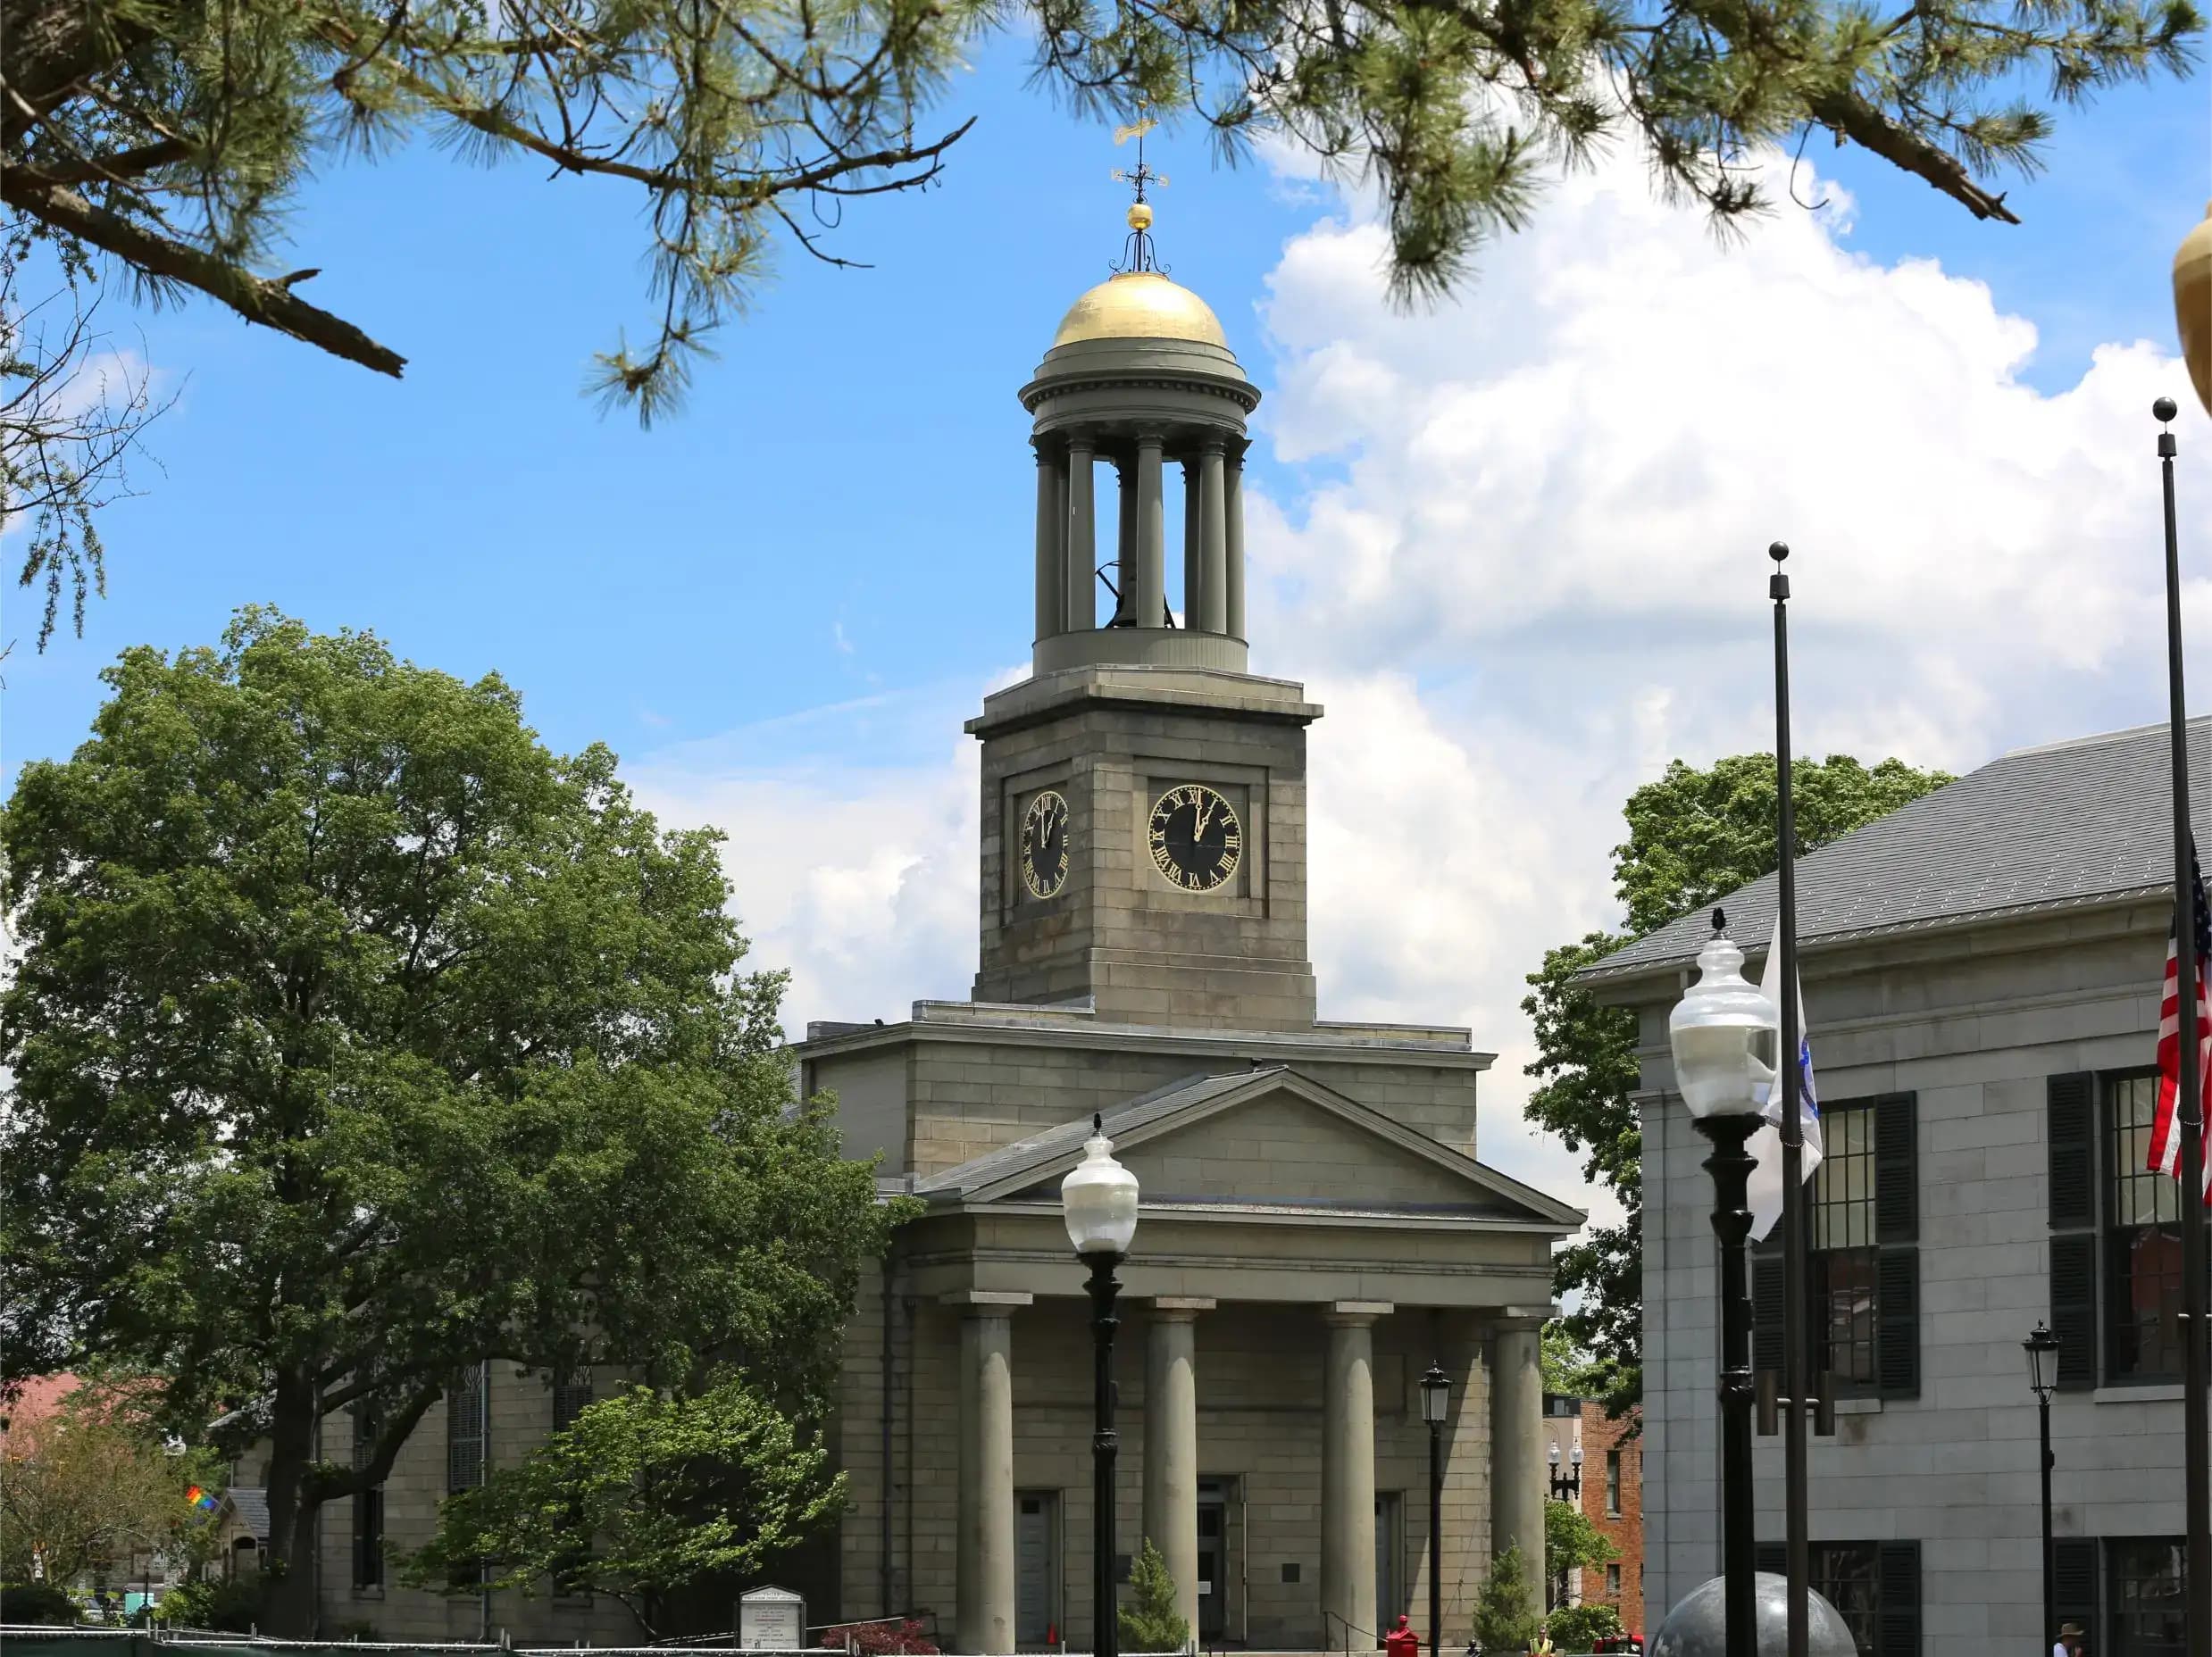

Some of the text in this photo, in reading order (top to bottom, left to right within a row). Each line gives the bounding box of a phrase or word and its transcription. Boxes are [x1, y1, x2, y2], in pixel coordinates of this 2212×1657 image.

[1169, 791, 1185, 811] XI
[1187, 790, 1203, 804] XI
[1156, 805, 1172, 824] X
[1219, 813, 1233, 828] II
[1153, 828, 1165, 843] IX
[1224, 833, 1238, 849] III
[1155, 844, 1172, 870] VIII
[1216, 850, 1235, 872] IIII
[1188, 872, 1203, 887] VI
[1210, 870, 1221, 887] V
